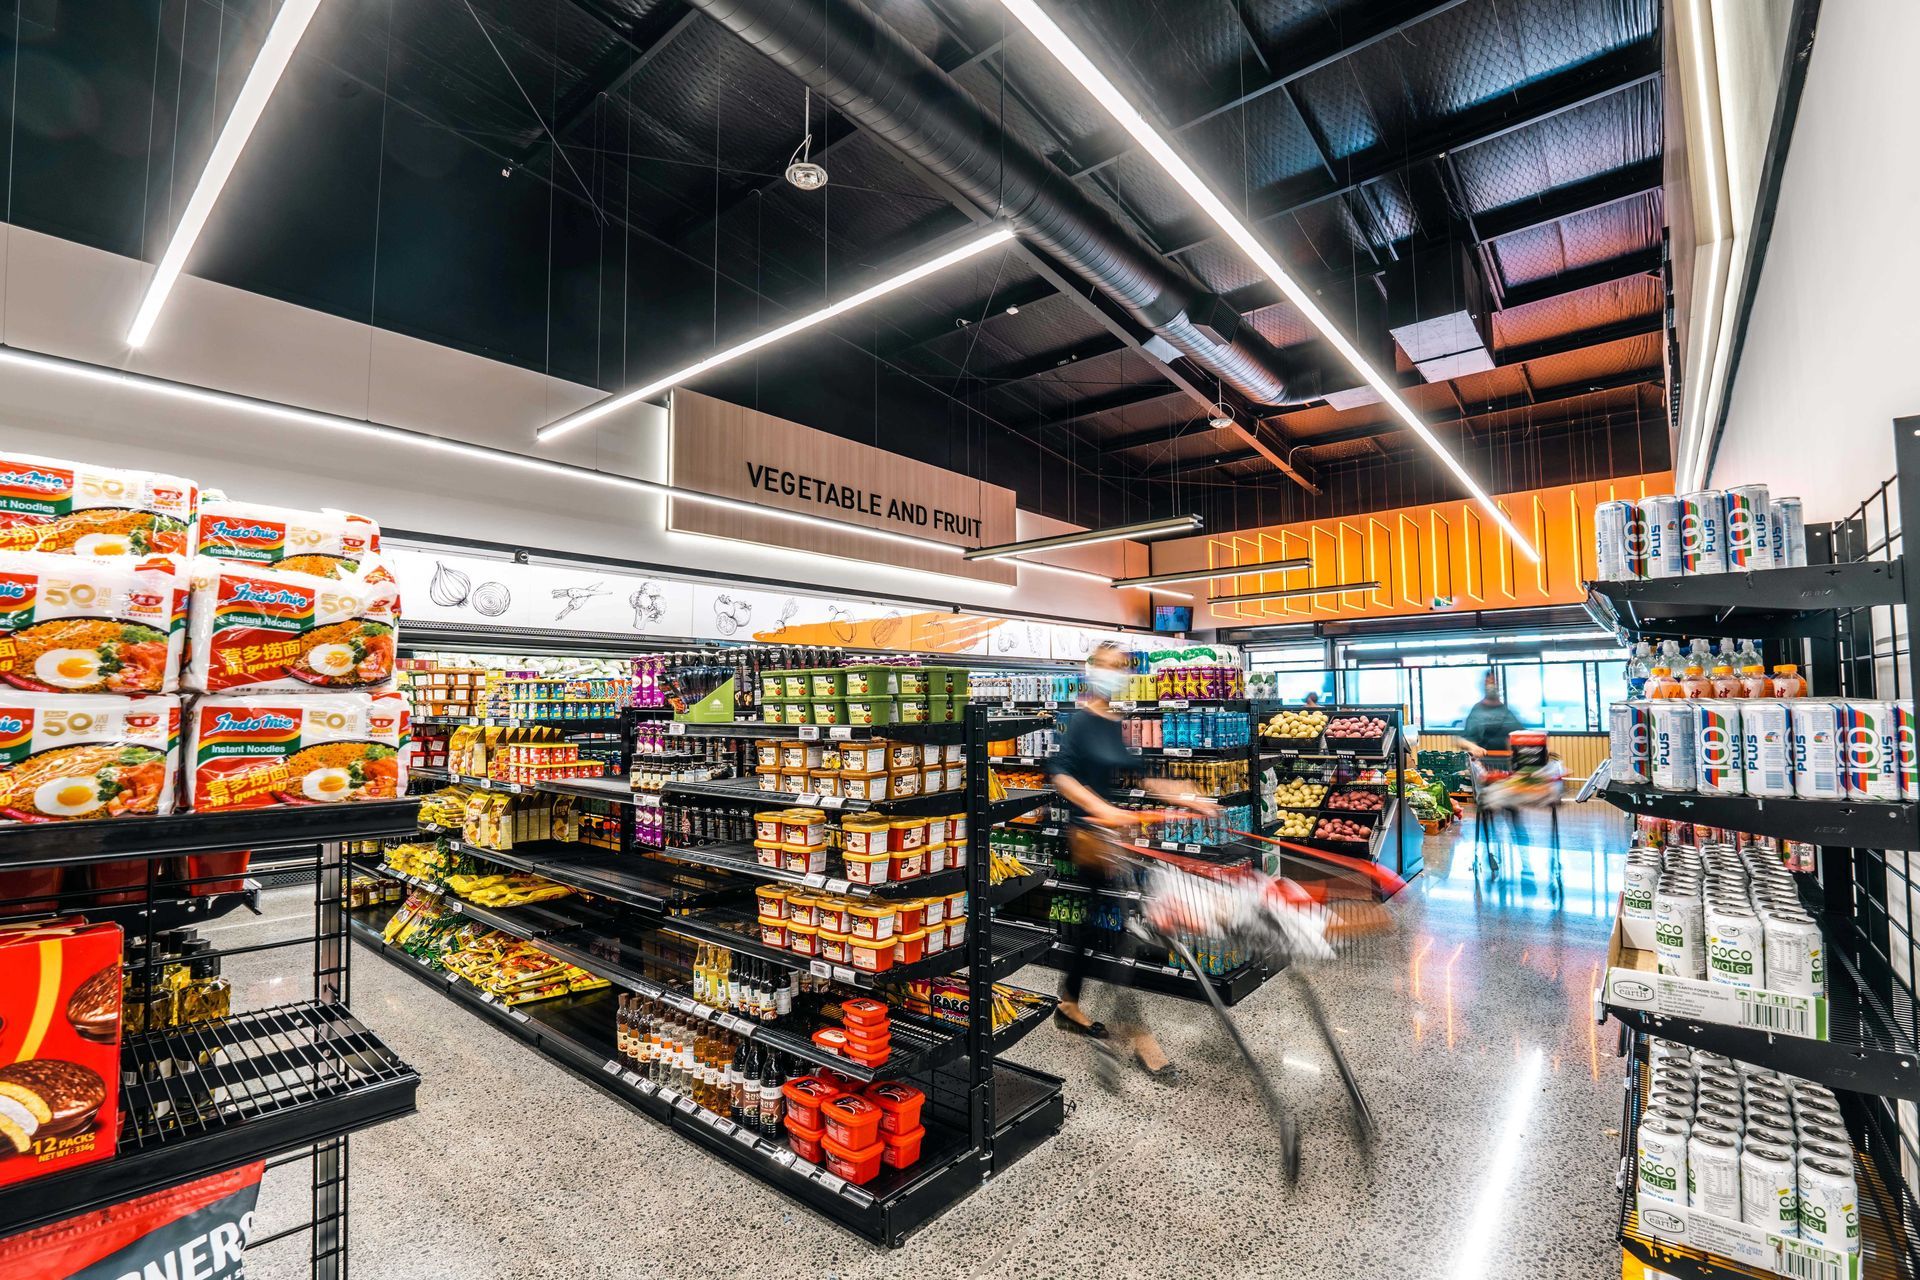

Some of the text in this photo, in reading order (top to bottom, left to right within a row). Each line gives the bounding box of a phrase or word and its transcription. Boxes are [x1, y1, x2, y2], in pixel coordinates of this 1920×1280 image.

[9, 500, 55, 514] Noodles
[747, 462, 982, 538] VEGETABLE AND FRUIT
[1651, 524, 1661, 558] PLUS
[1704, 519, 1715, 553] PLUS
[1755, 513, 1768, 548] PLUS
[1772, 526, 1782, 559] PLUS
[239, 549, 272, 560] Noodles
[42, 710, 94, 737] 50
[211, 744, 286, 753] Instant Noodles
[1659, 732, 1670, 766] PLUS
[1700, 726, 1731, 772] 100
[1731, 734, 1741, 770] PLUS
[1747, 734, 1759, 771] PLUS
[1796, 735, 1807, 772] PLUS
[1847, 726, 1882, 776] 100
[1882, 735, 1895, 774] PLUS
[1712, 958, 1752, 975] water
[1619, 988, 1648, 999] earth
[32, 1132, 96, 1155] 12 PACKS
[39, 1152, 55, 1163] NET
[76, 1143, 95, 1153] 336g
[1649, 1216, 1678, 1230] earth
